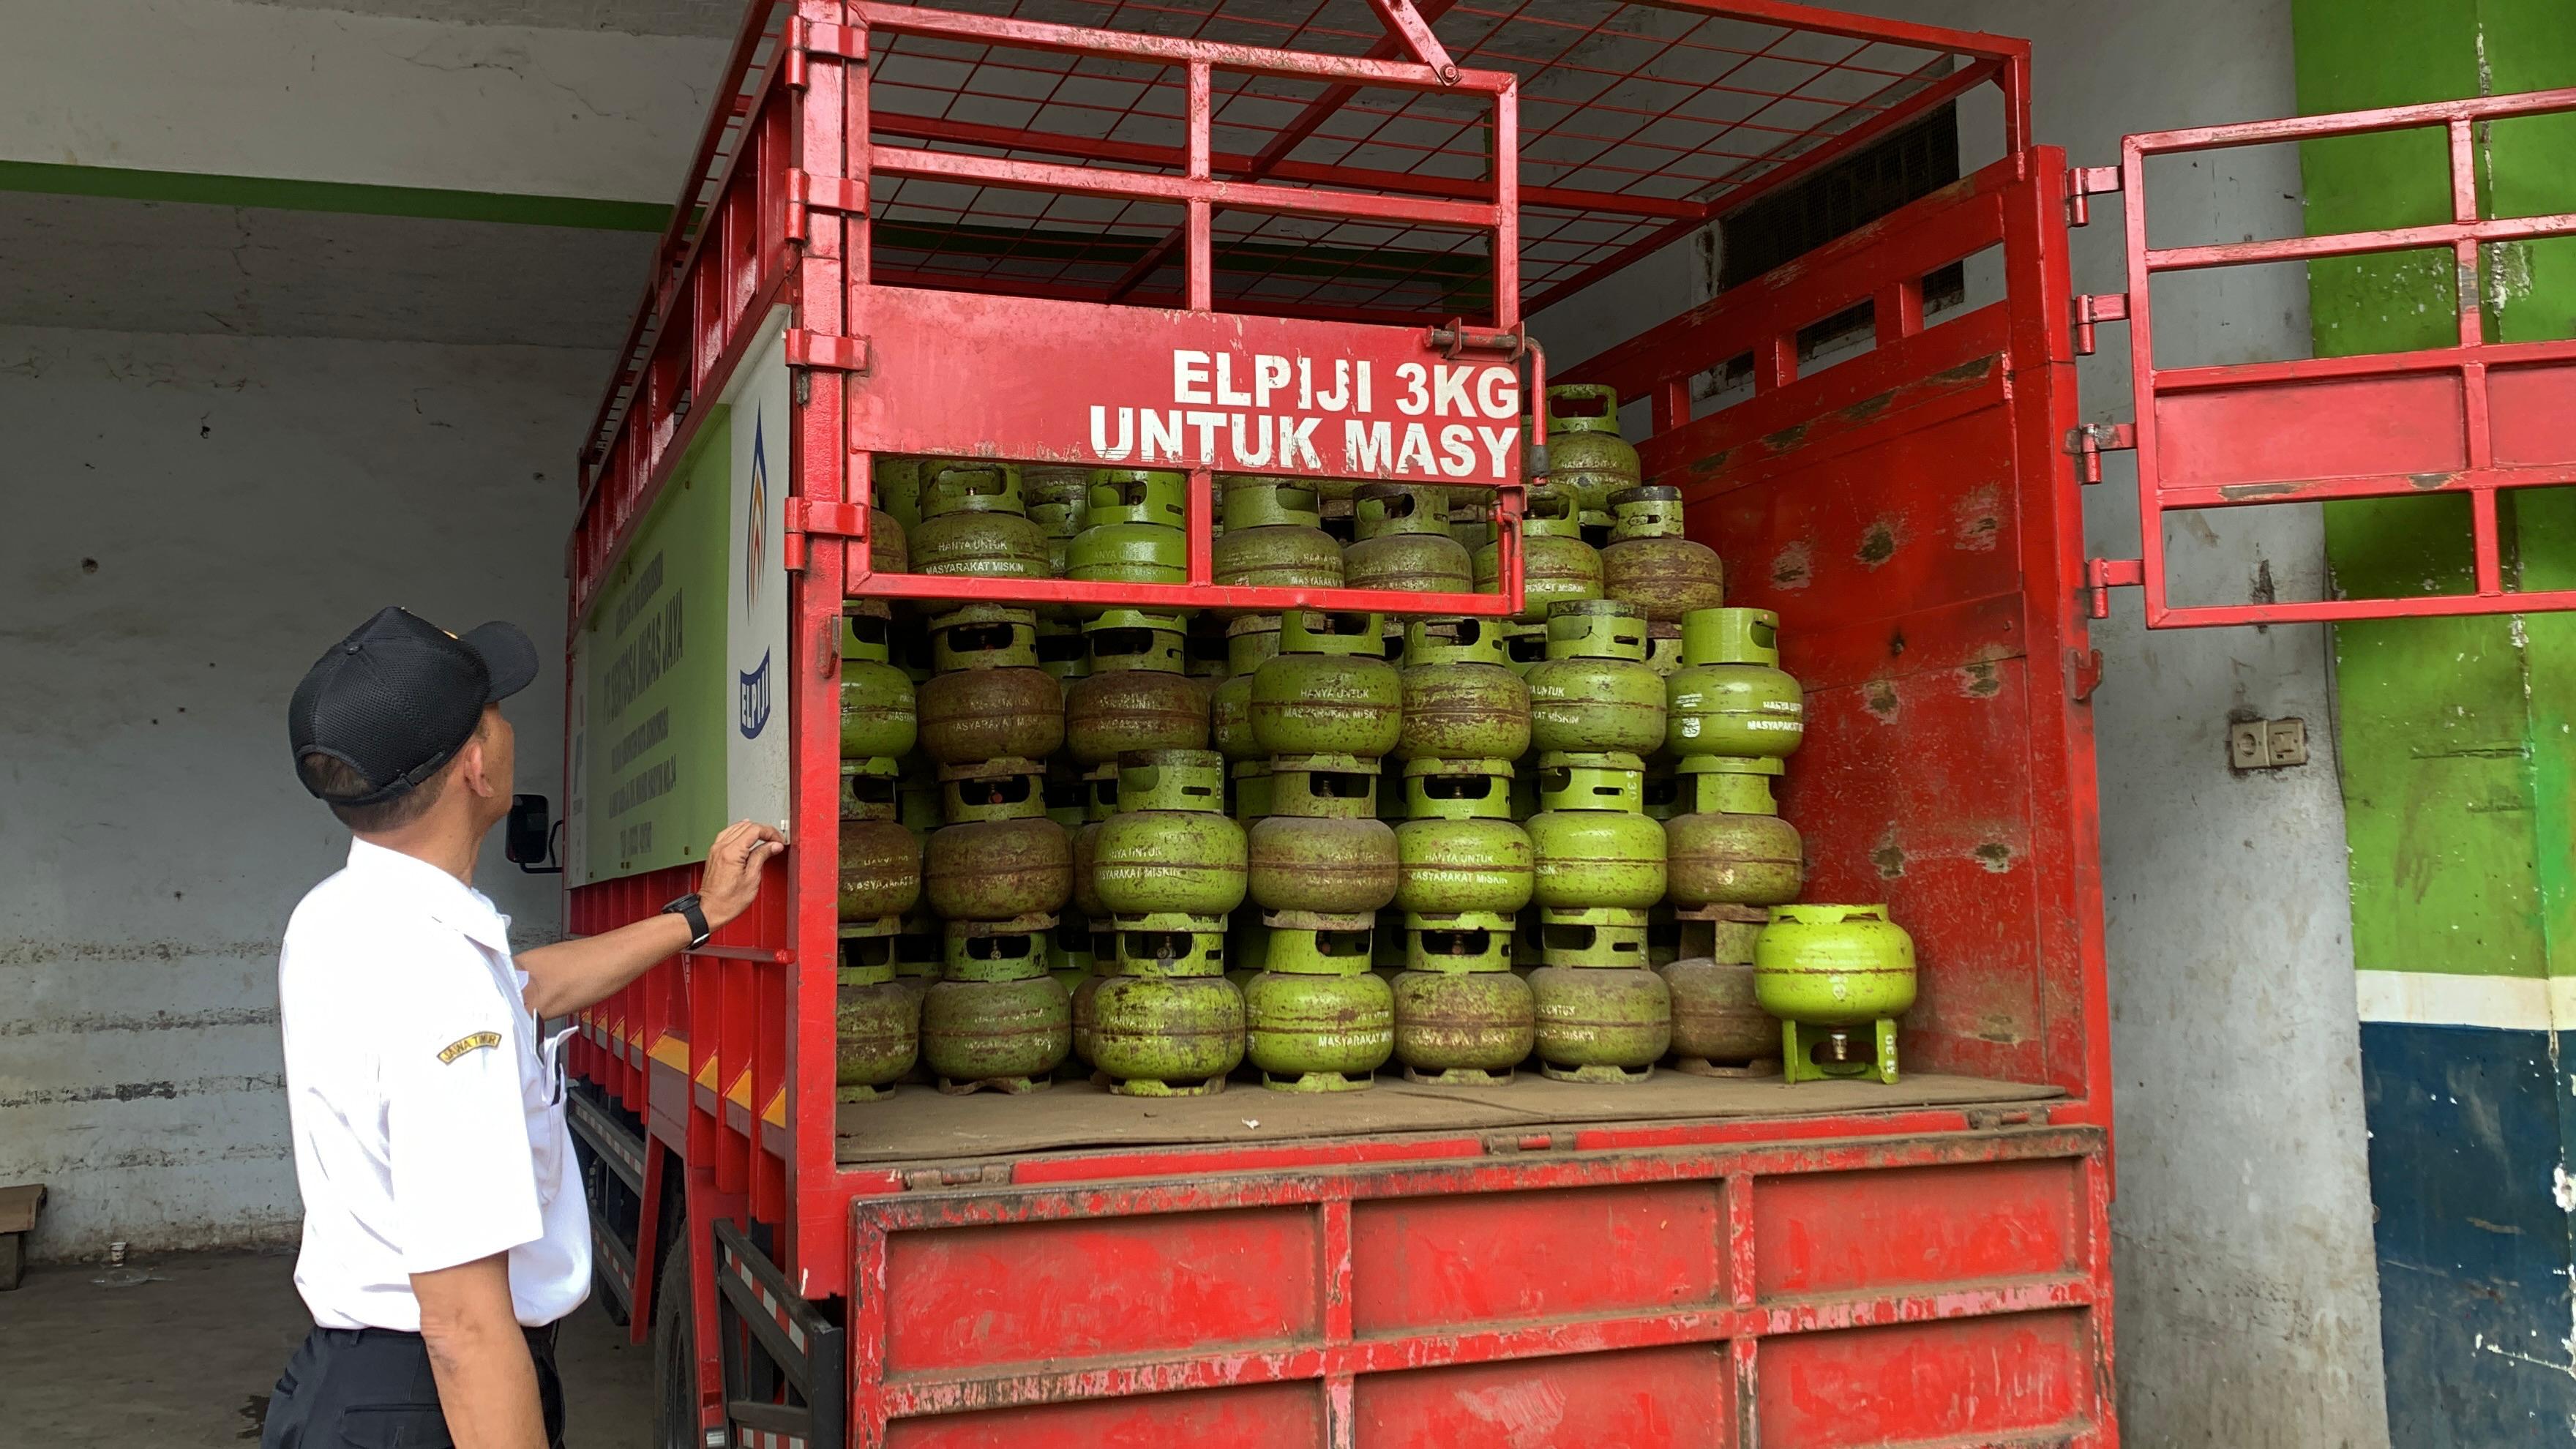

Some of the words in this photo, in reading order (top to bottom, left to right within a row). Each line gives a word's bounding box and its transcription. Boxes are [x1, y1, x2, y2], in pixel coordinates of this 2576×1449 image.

[1173, 348, 1371, 413] ELPIJI
[1395, 362, 1519, 419] 3KG
[1090, 405, 1324, 470] UNTUK
[1344, 419, 1519, 479] MASY
[938, 541, 971, 551] HANYA
[973, 539, 1008, 550] UNTUK
[926, 561, 990, 574] MASYARAKAT
[992, 561, 1024, 572] MISKIN
[611, 640, 637, 722] SENTOSA
[637, 611, 662, 699] MIGAS
[662, 587, 683, 675] JAYA
[741, 662, 769, 729] ELPIJI
[1300, 689, 1335, 698] HANYA
[1336, 689, 1369, 699] UNTUK
[1548, 711, 1579, 724] MISKIN
[1461, 853, 1494, 864] UNTUK
[1476, 874, 1508, 885] MISKIN
[1318, 1033, 1379, 1047] MASYARAKAT
[443, 1039, 471, 1061] JAWA
